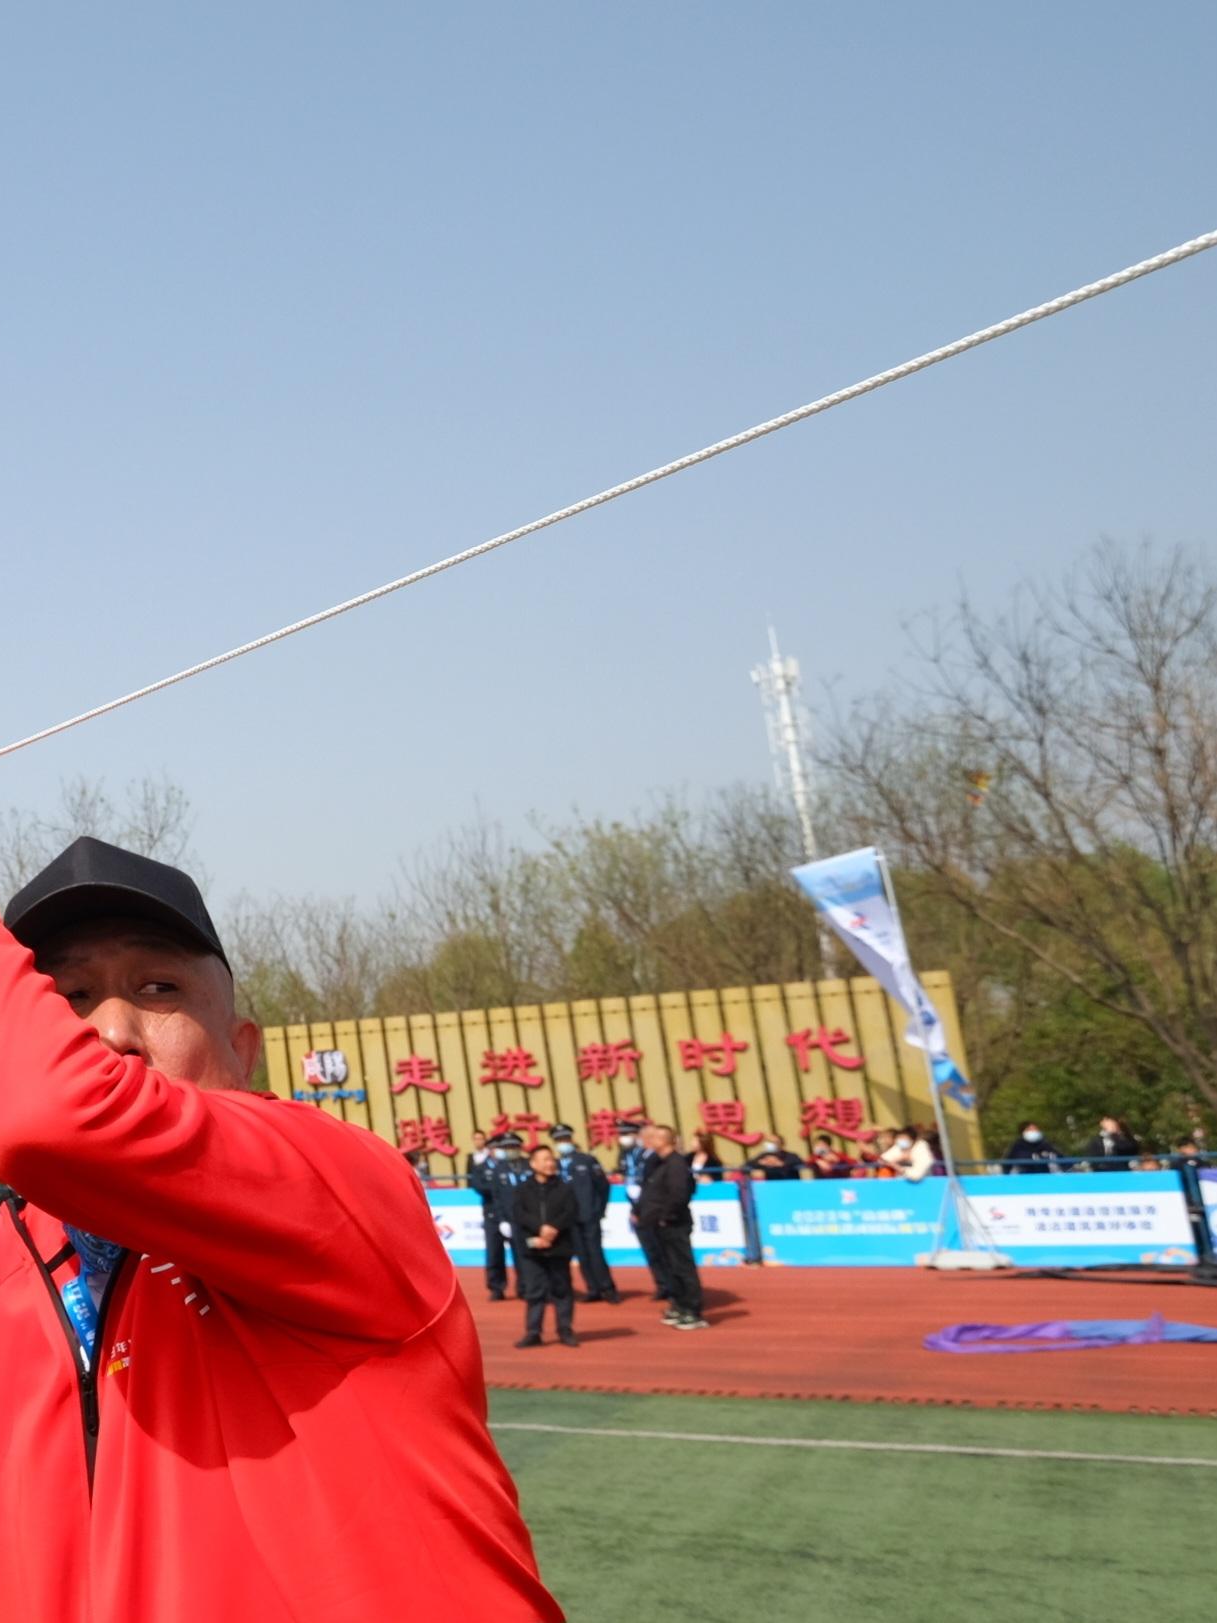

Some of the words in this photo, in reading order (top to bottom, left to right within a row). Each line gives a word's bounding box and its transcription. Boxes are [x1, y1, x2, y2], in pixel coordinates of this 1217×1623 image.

[391, 1024, 865, 1094] 走进新时代
[396, 1097, 878, 1157] 践行新思想
